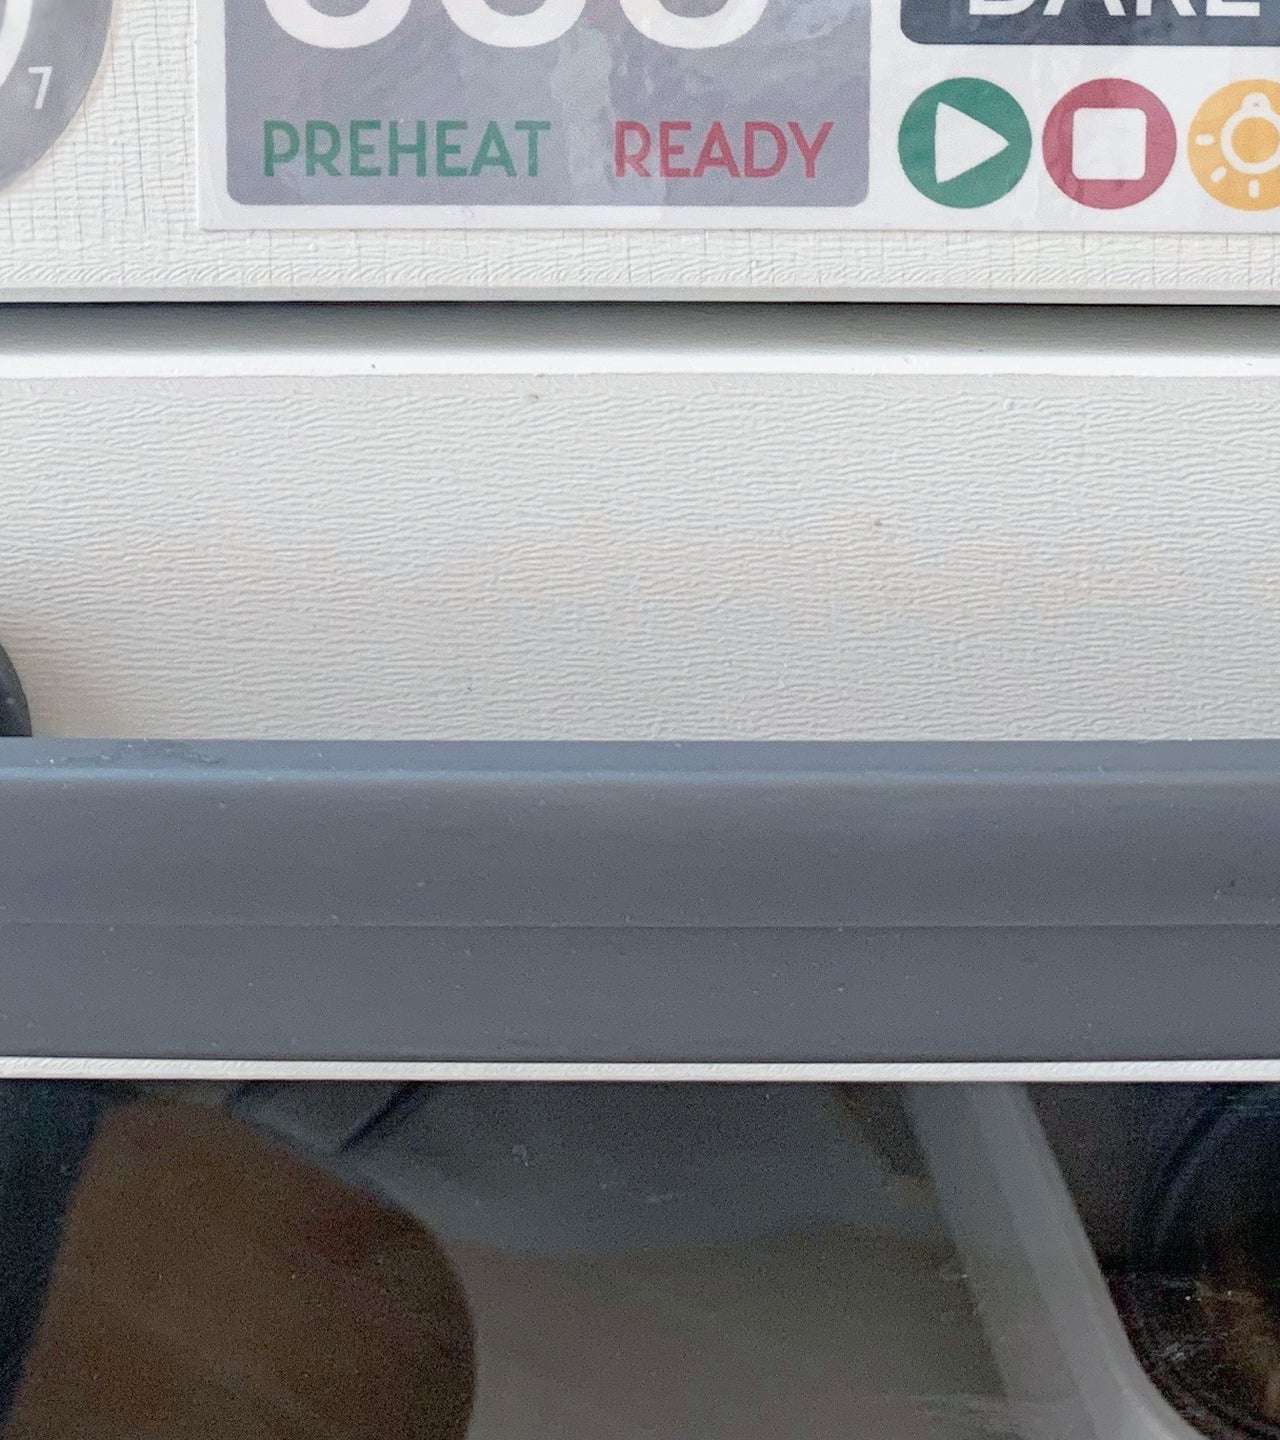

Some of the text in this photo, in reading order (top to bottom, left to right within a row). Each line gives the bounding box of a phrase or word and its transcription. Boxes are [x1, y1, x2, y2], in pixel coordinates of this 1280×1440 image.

[27, 66, 53, 109] 7
[262, 119, 834, 178] PREHEAT READY
